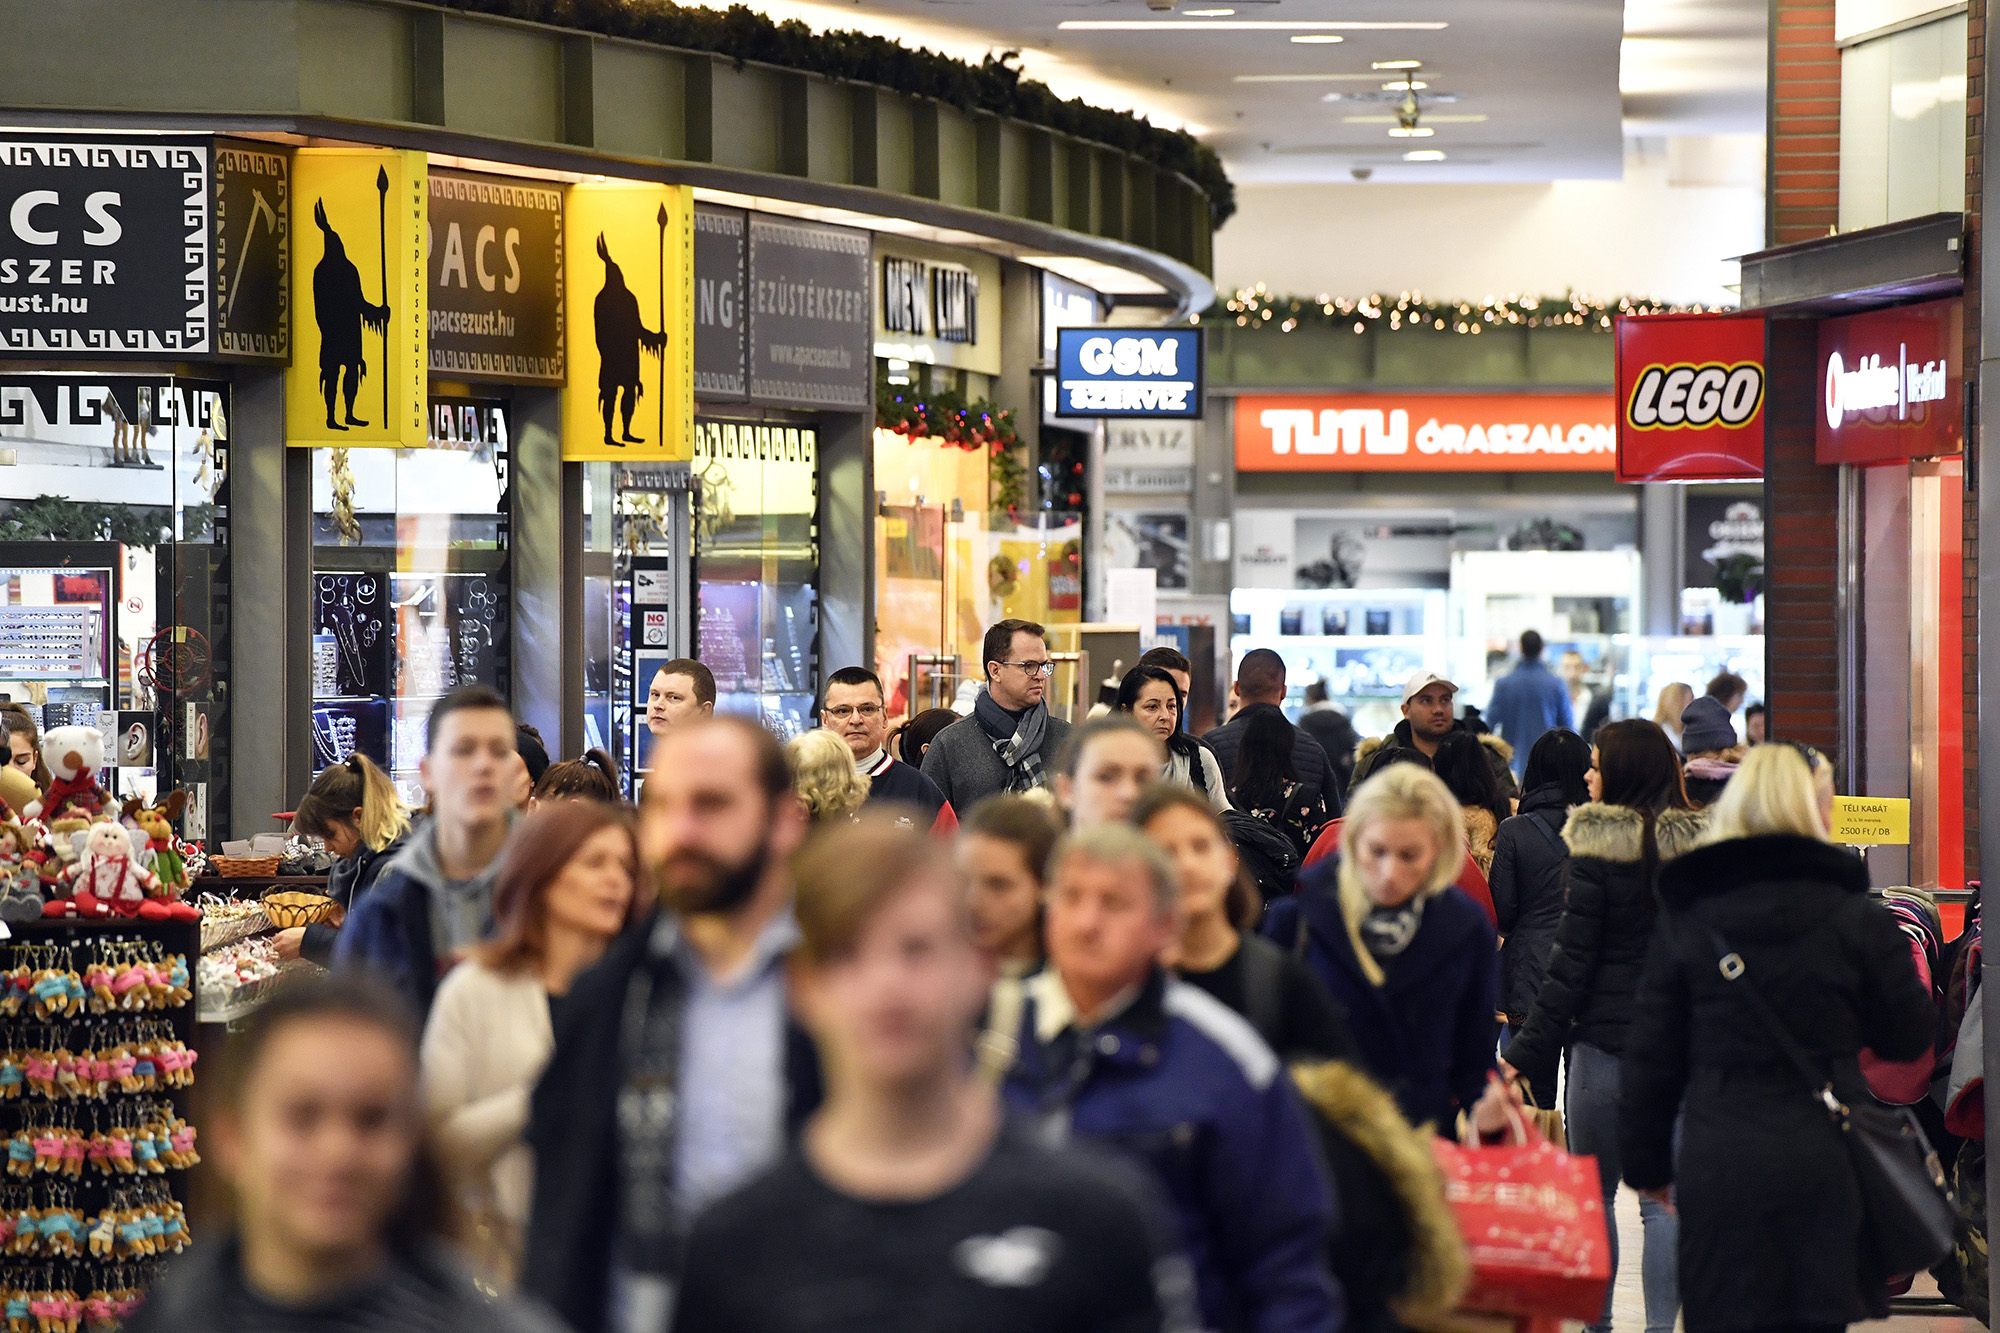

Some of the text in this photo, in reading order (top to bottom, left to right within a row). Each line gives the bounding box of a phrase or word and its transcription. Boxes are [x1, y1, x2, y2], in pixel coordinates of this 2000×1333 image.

[1079, 337, 1179, 376] GSM
[1070, 388, 1188, 410] SZERVIZ
[1628, 362, 1764, 430] LEGO
[1261, 409, 1617, 455] TUTU ÓRASZALON
[647, 614, 664, 622] NO
[1843, 804, 1888, 813] TÉLI KABÁT
[1840, 827, 1890, 836] 2500 Ft / DB
